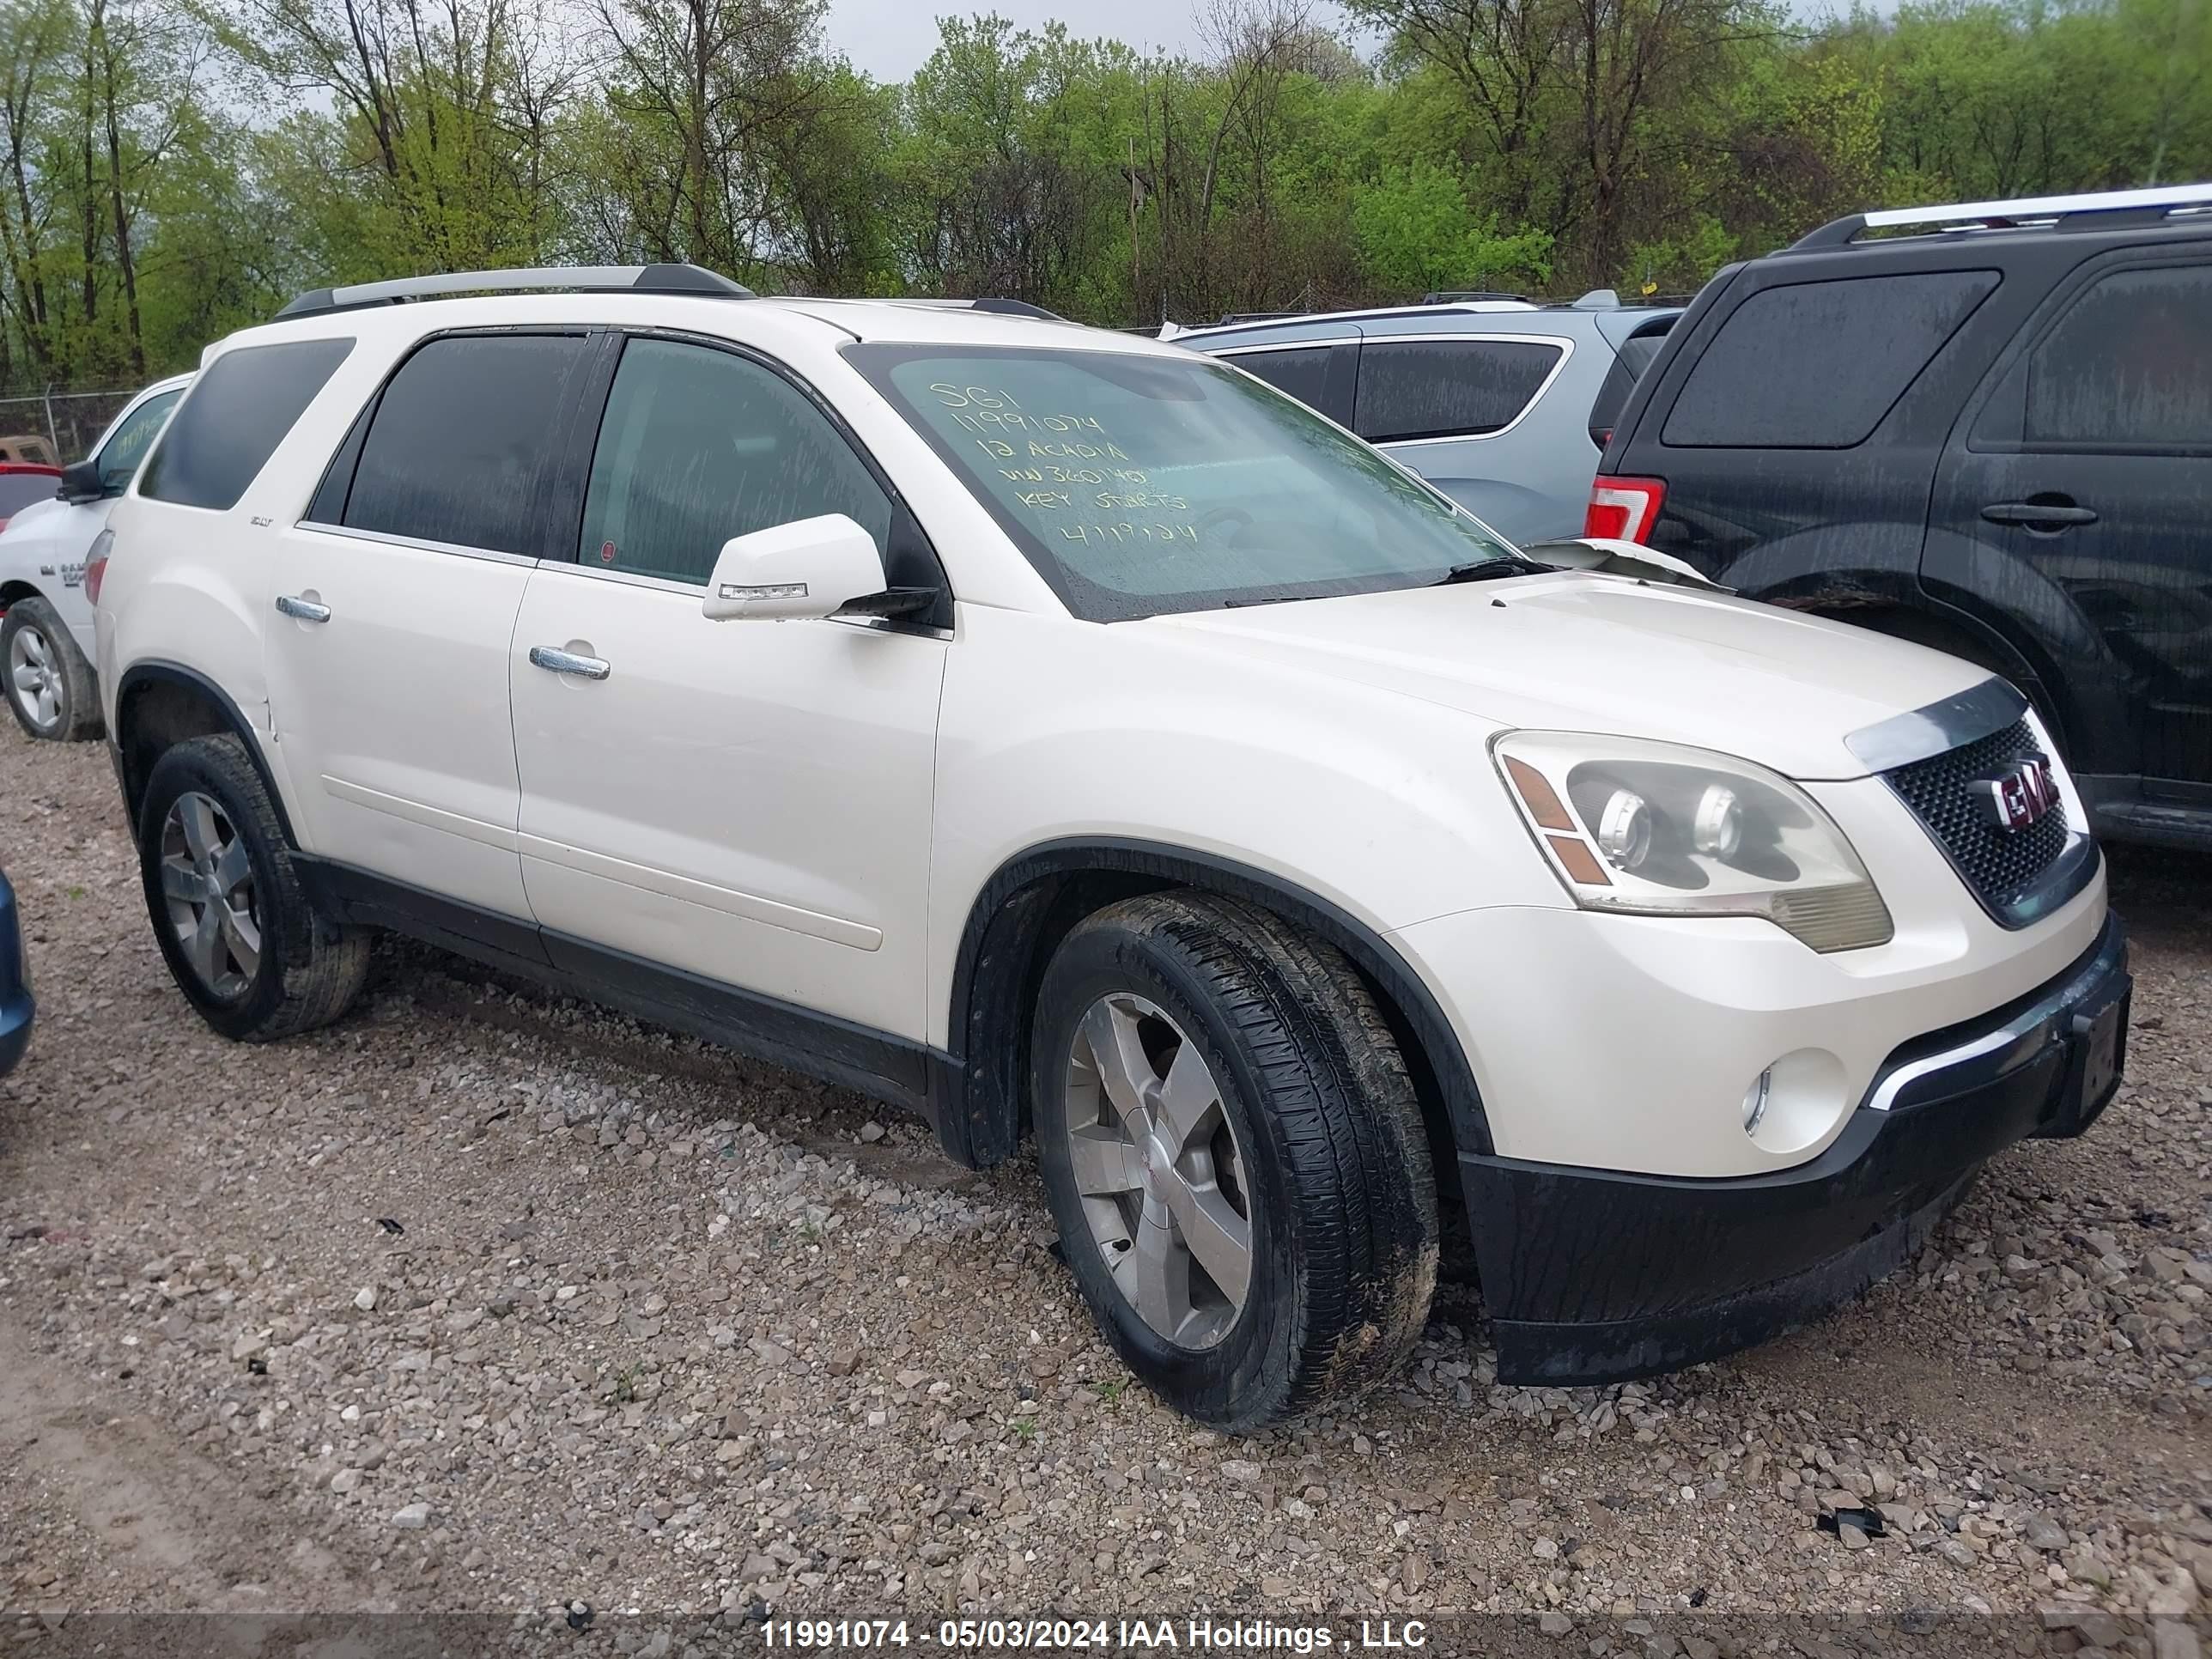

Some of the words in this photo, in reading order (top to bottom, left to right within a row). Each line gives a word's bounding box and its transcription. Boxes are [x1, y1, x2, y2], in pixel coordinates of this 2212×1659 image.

[951, 411, 1105, 434] 11991074
[976, 440, 1017, 460] 12
[1029, 440, 1129, 461] ACADIA
[1015, 492, 1072, 509] KEY
[1095, 492, 1188, 509] STARTS
[1990, 756, 2061, 834] GMC
